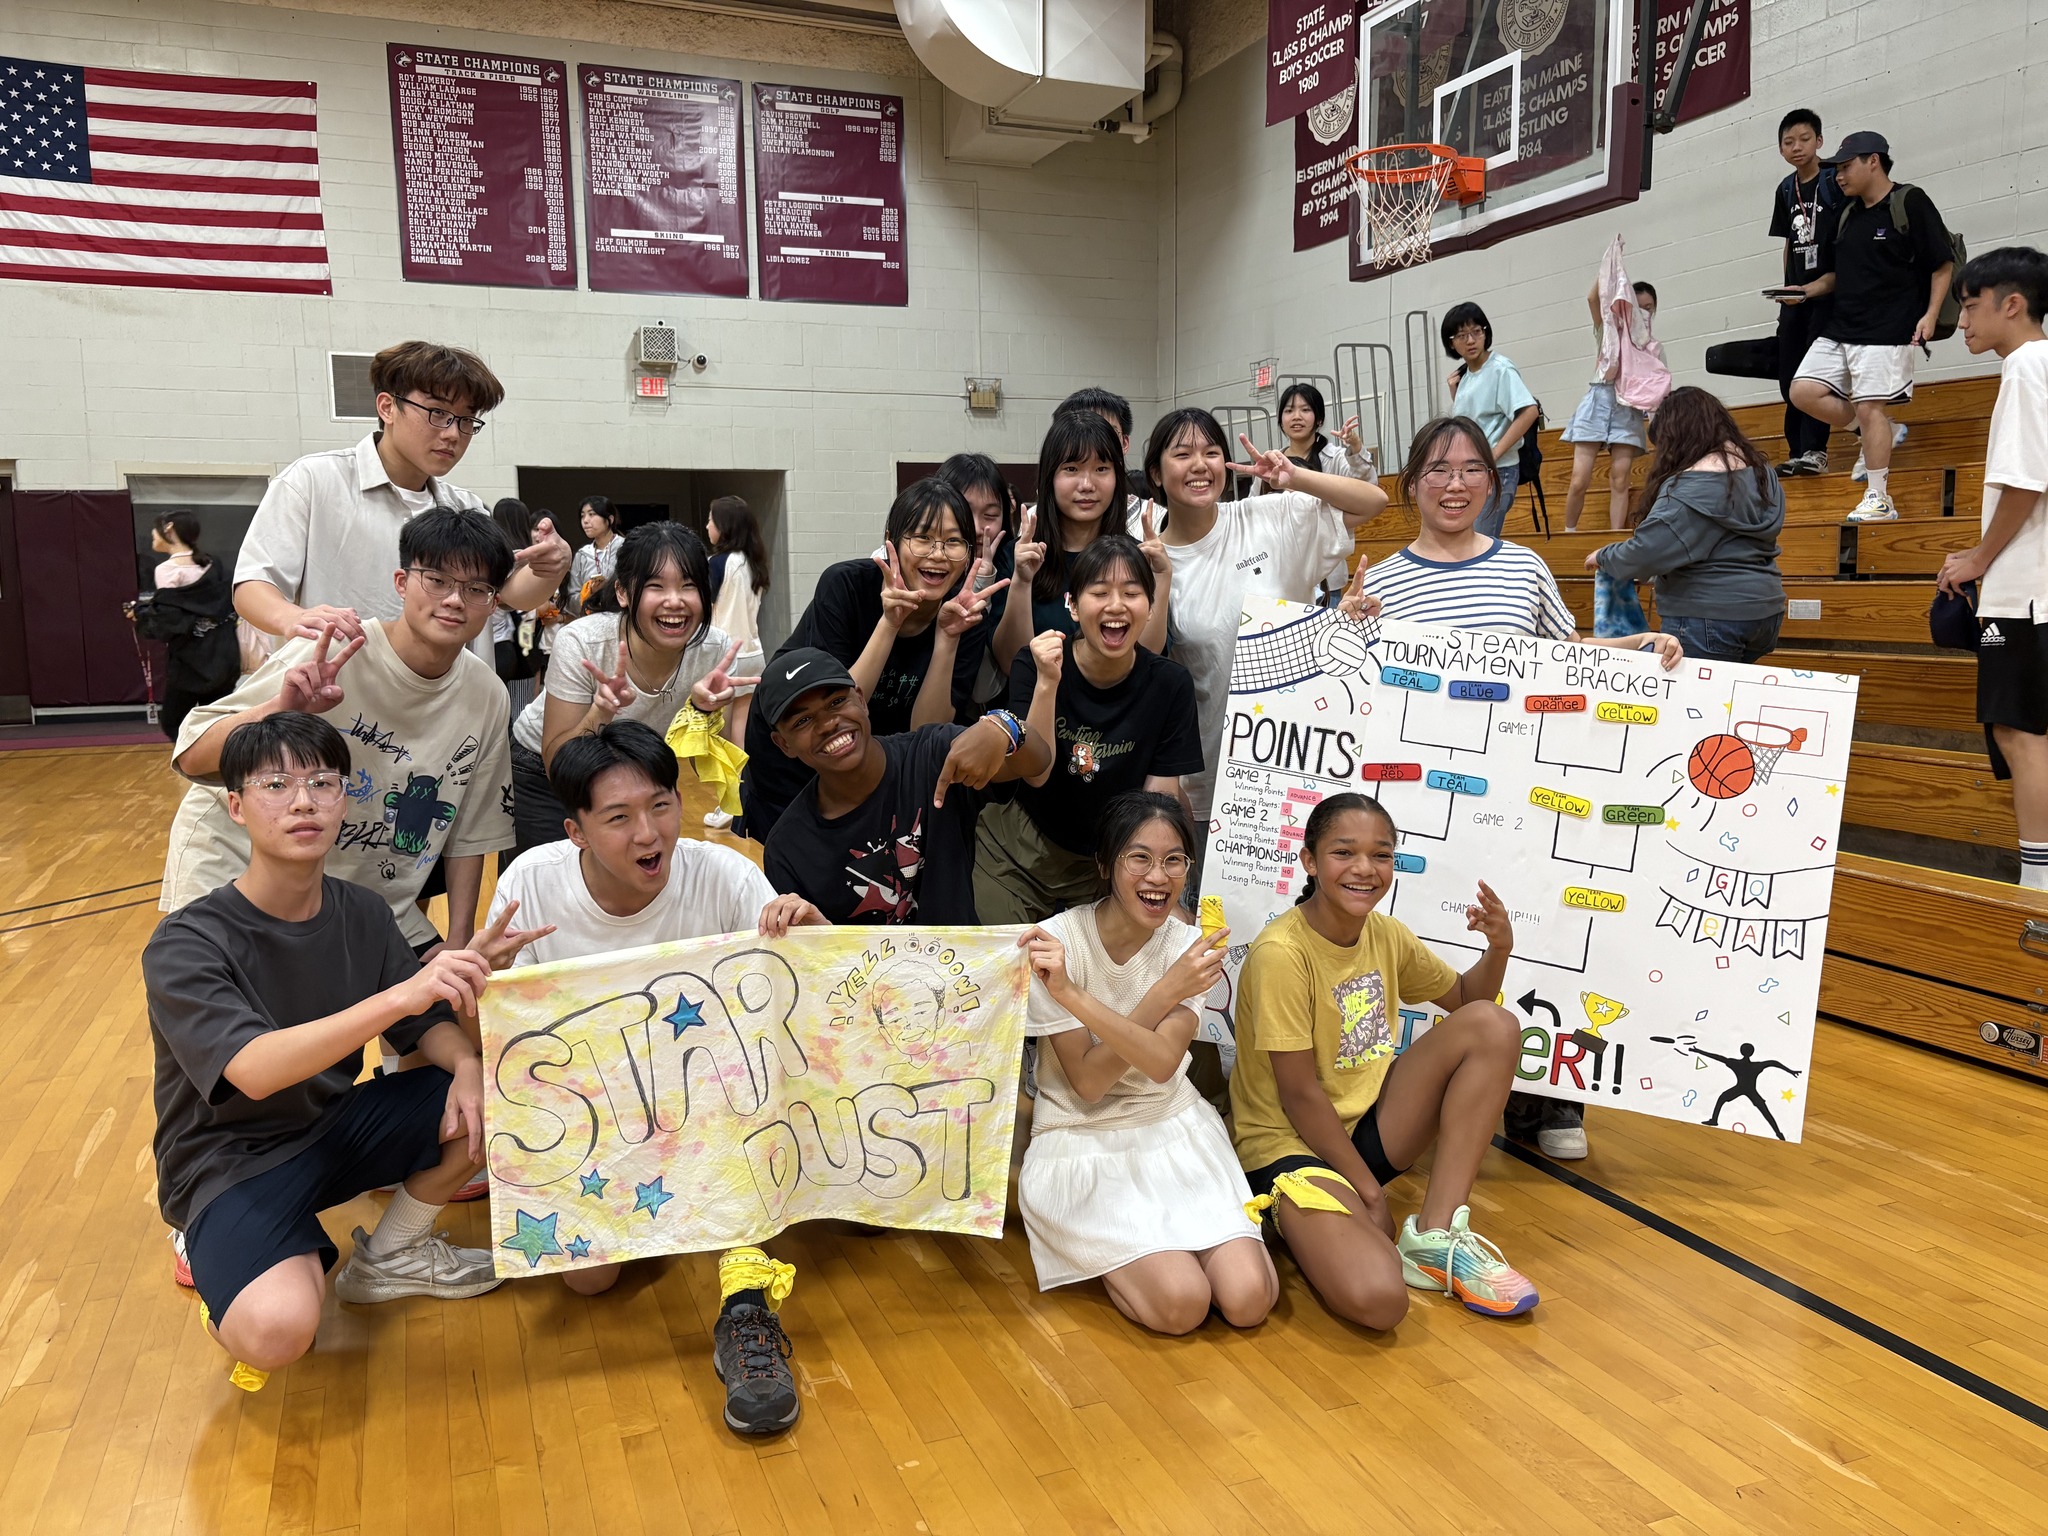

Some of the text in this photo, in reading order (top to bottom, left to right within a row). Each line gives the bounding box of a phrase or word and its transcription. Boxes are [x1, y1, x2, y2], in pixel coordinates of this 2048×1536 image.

[1296, 5, 1325, 34] STATE
[1273, 9, 1353, 67] CLASS B CHAMPS
[416, 52, 540, 75] STATE CHAMPIONS
[1279, 38, 1345, 85] BOYS SOCCER
[399, 73, 456, 86] ROY POMEROY
[444, 69, 476, 78] TRACK
[489, 73, 516, 82] FIELD
[604, 72, 718, 94] STATE CHAMPIONS
[1298, 71, 1319, 95] 1980
[1483, 73, 1537, 110] EASTRN
[1539, 52, 1583, 88] MAINE
[399, 81, 437, 92] WILLIAM
[439, 85, 477, 96] LABARGE
[540, 95, 559, 104] 1967
[588, 93, 648, 106] CHRIS COMFORT
[637, 89, 689, 100] WRESTLING
[776, 90, 881, 109] STATE CHAMPIONS
[1528, 73, 1588, 113] CHAMPS
[400, 96, 438, 107] DOUGLAS
[440, 100, 475, 110] LATHAM
[401, 104, 560, 126] RICKY THOMPSON 1977
[779, 133, 803, 142] DUGAS
[592, 166, 670, 179] PATRICK HAPWORTH
[406, 180, 434, 189] JENNA
[437, 183, 485, 193] LORENTSEN
[1310, 168, 1348, 196] CHAMPS
[407, 203, 565, 220] NATASHA WALLACE 2012
[764, 200, 787, 208] PETER
[789, 202, 824, 210] LOGIODICE
[1319, 208, 1339, 228] 1994
[654, 232, 684, 240] SKIING
[785, 229, 822, 237] WHITAKER
[410, 241, 457, 250] SAMANTHA
[460, 244, 492, 252] MARTIN
[595, 237, 614, 245] JEFF
[616, 238, 648, 247] GILMORE
[596, 245, 666, 255] CAROLINE WRIGHT
[642, 378, 664, 395] EXIT
[1980, 635, 2006, 644] adidas
[1552, 644, 1610, 668] CAMP
[1056, 716, 1103, 744] Scouting
[1228, 712, 1356, 780] POINTS
[1265, 774, 1271, 785] 1
[1234, 781, 1264, 796] Winning
[1233, 793, 1257, 807] Losing
[1260, 809, 1268, 822] 2
[1514, 816, 1523, 831] 2
[1229, 817, 1258, 832] Winning
[1228, 829, 1253, 844] Losing
[1215, 840, 1298, 865] CHAMPIONSHIP
[1222, 855, 1253, 871] Winning
[1221, 869, 1249, 886] Losing
[1715, 873, 1764, 896] GO
[489, 948, 809, 1188] STAR
[742, 1078, 996, 1222] DUST
